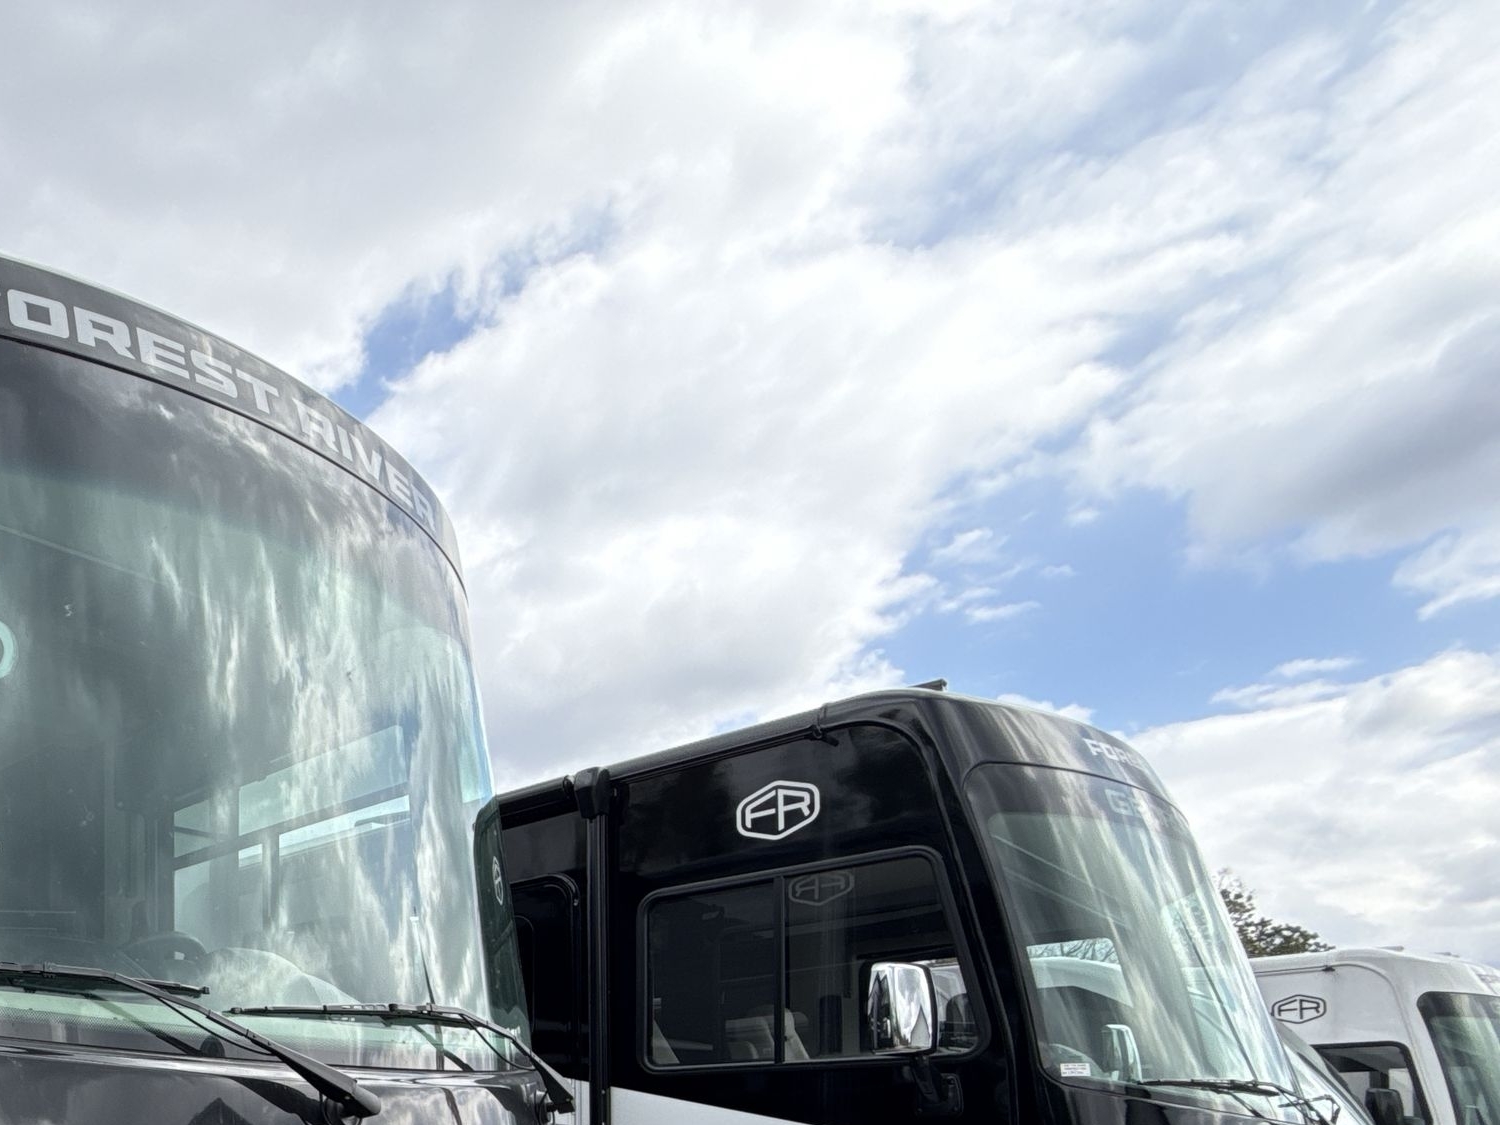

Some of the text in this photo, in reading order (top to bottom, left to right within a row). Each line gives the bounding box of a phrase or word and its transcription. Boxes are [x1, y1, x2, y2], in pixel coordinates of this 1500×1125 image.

[292, 397, 436, 533] RIVER
[744, 788, 811, 831] FR
[1277, 998, 1321, 1020] FR
